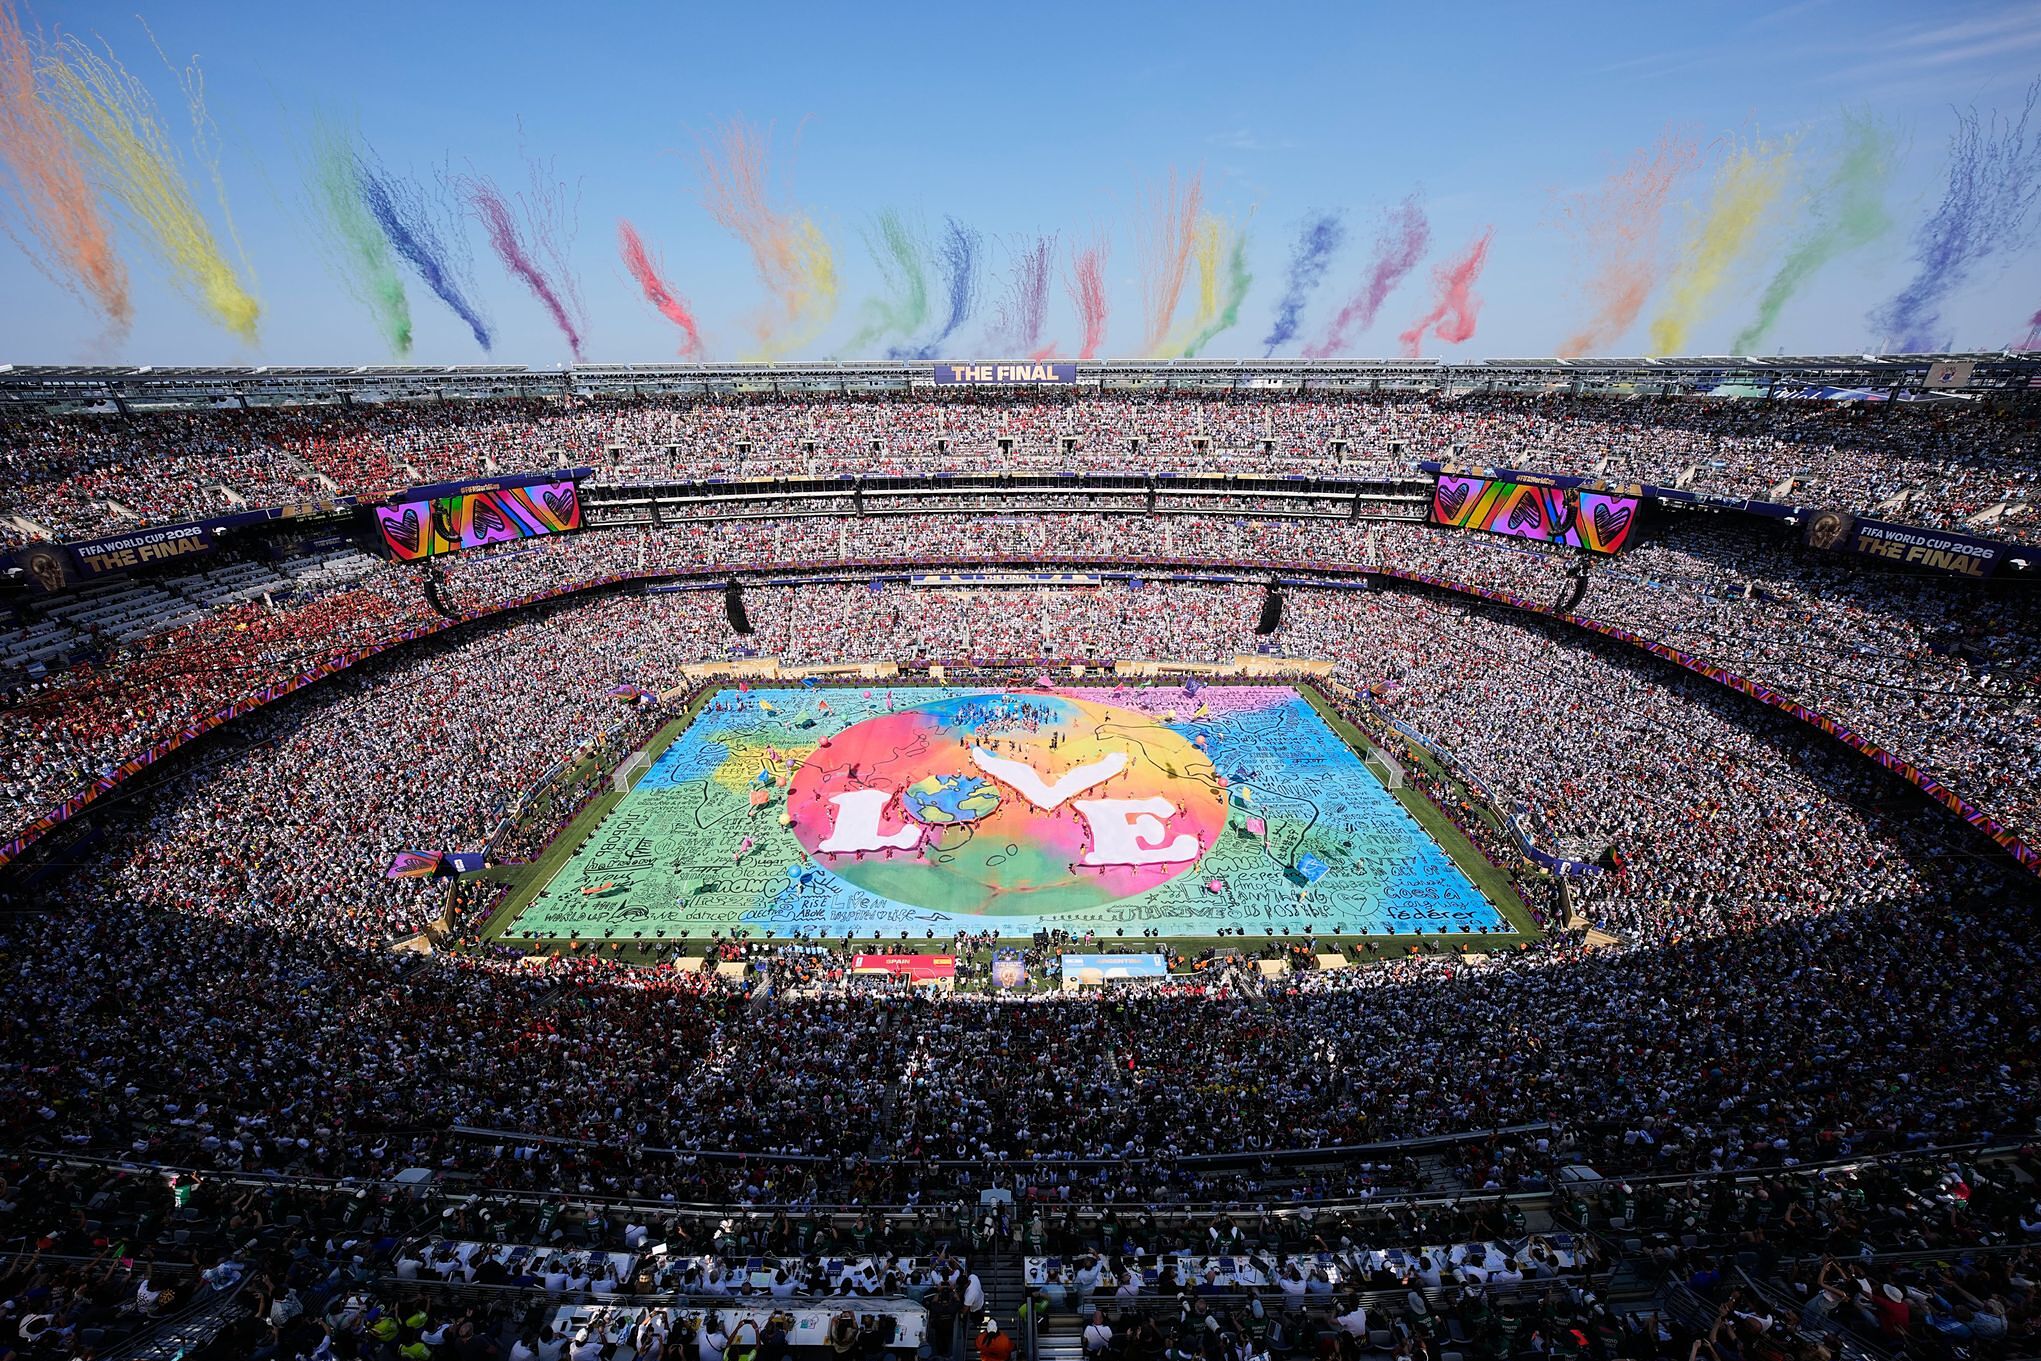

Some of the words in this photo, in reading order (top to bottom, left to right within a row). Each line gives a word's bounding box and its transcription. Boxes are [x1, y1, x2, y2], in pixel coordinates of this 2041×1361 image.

[951, 365, 993, 381] THE
[997, 365, 1060, 381] FINAL
[79, 545, 104, 557] FIFA
[104, 537, 144, 551] WORLD
[145, 533, 166, 544] CUP
[167, 526, 202, 540] 2026
[83, 549, 138, 573] THE
[138, 536, 209, 562] FINAL
[1858, 536, 1906, 559] THE
[1905, 545, 1984, 577] FINAL
[1860, 526, 1883, 539] FIFA
[1885, 530, 1926, 546] WORLD
[1926, 538, 1951, 550] CUP
[1951, 543, 1995, 559] 2026
[1205, 855, 1272, 875] MUSIC
